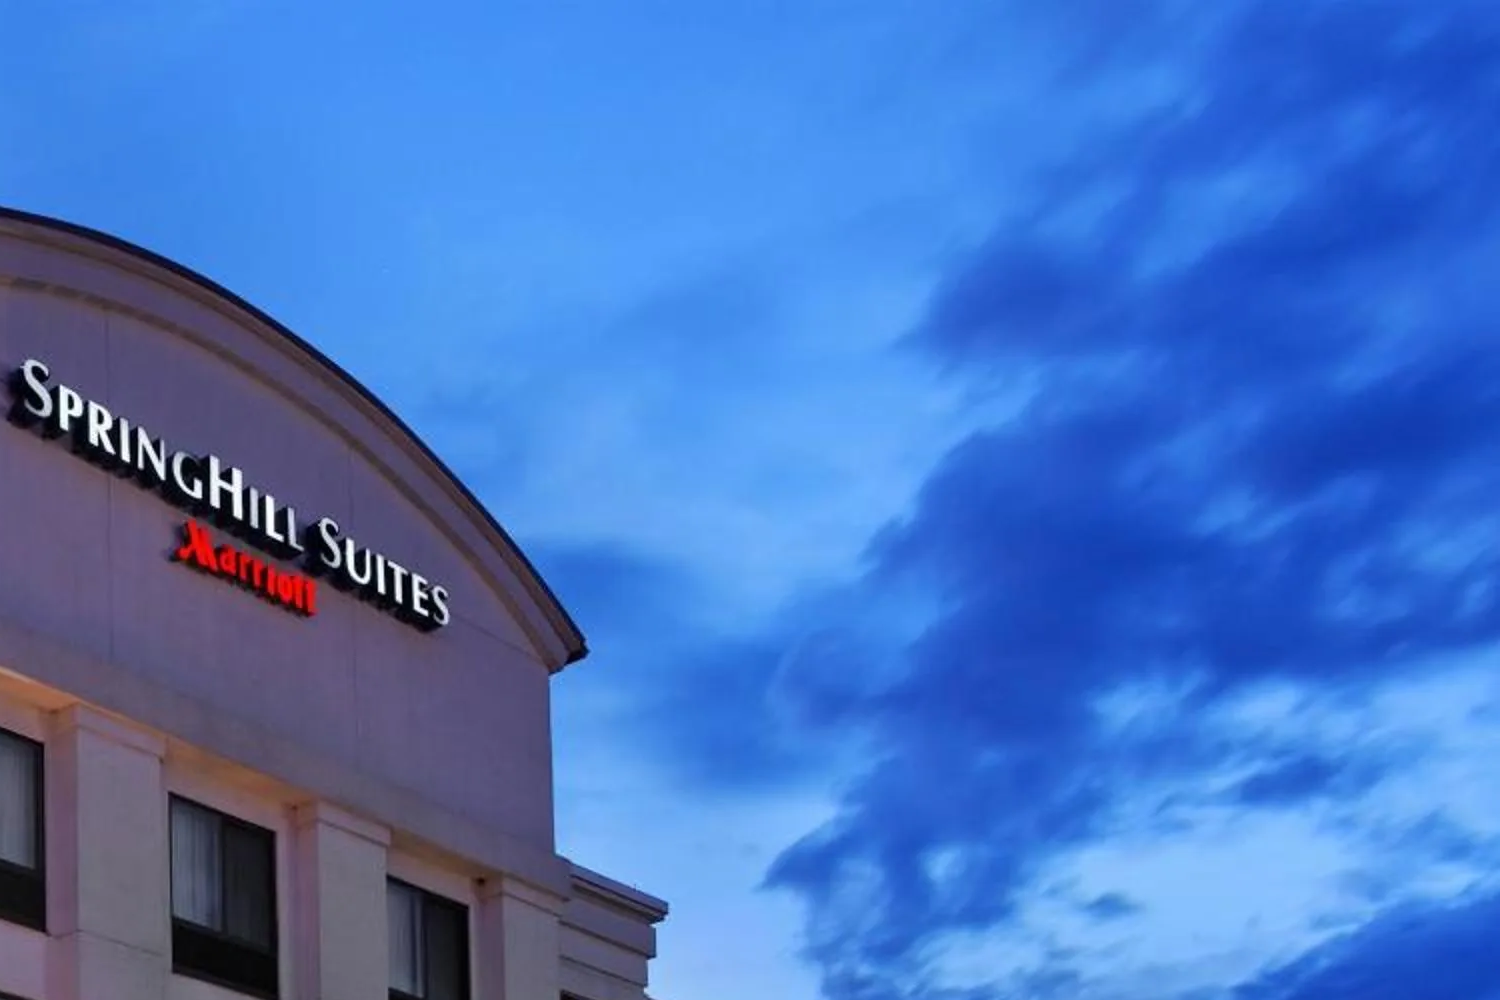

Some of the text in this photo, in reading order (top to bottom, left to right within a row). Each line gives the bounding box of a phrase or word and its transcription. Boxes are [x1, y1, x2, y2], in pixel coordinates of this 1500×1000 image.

[21, 359, 451, 627] SPRINGHILL SUITES
[176, 518, 318, 616] Marriott
